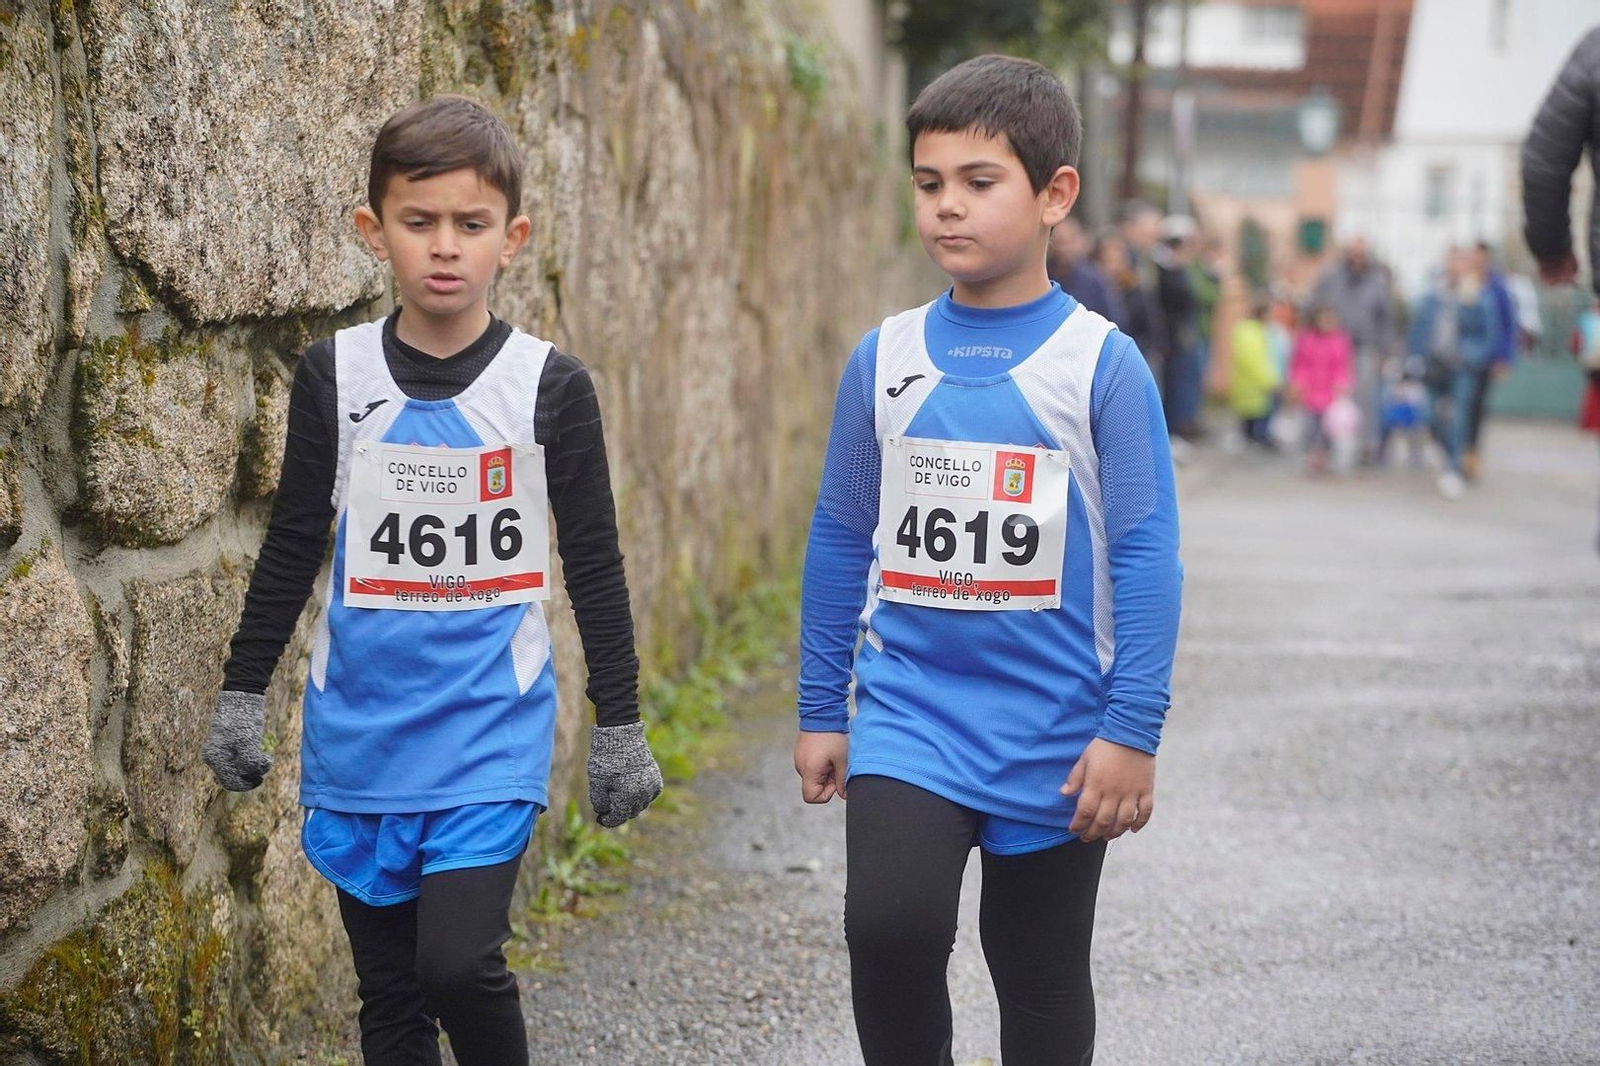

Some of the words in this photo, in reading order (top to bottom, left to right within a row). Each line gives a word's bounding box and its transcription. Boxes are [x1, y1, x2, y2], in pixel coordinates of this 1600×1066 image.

[388, 462, 468, 479] CONCELLO
[909, 455, 982, 473] CONCELLO
[396, 479, 415, 493] DE
[419, 480, 458, 494] VIGO
[915, 472, 932, 485] DE
[937, 473, 971, 488] VIGO
[370, 507, 523, 568] 4616
[896, 505, 1040, 567] 4619
[395, 588, 440, 603] terreo
[445, 589, 463, 603] de
[469, 587, 501, 603] xogo
[911, 582, 947, 599] terreo
[952, 586, 970, 601] de
[975, 589, 1011, 604] xogo
